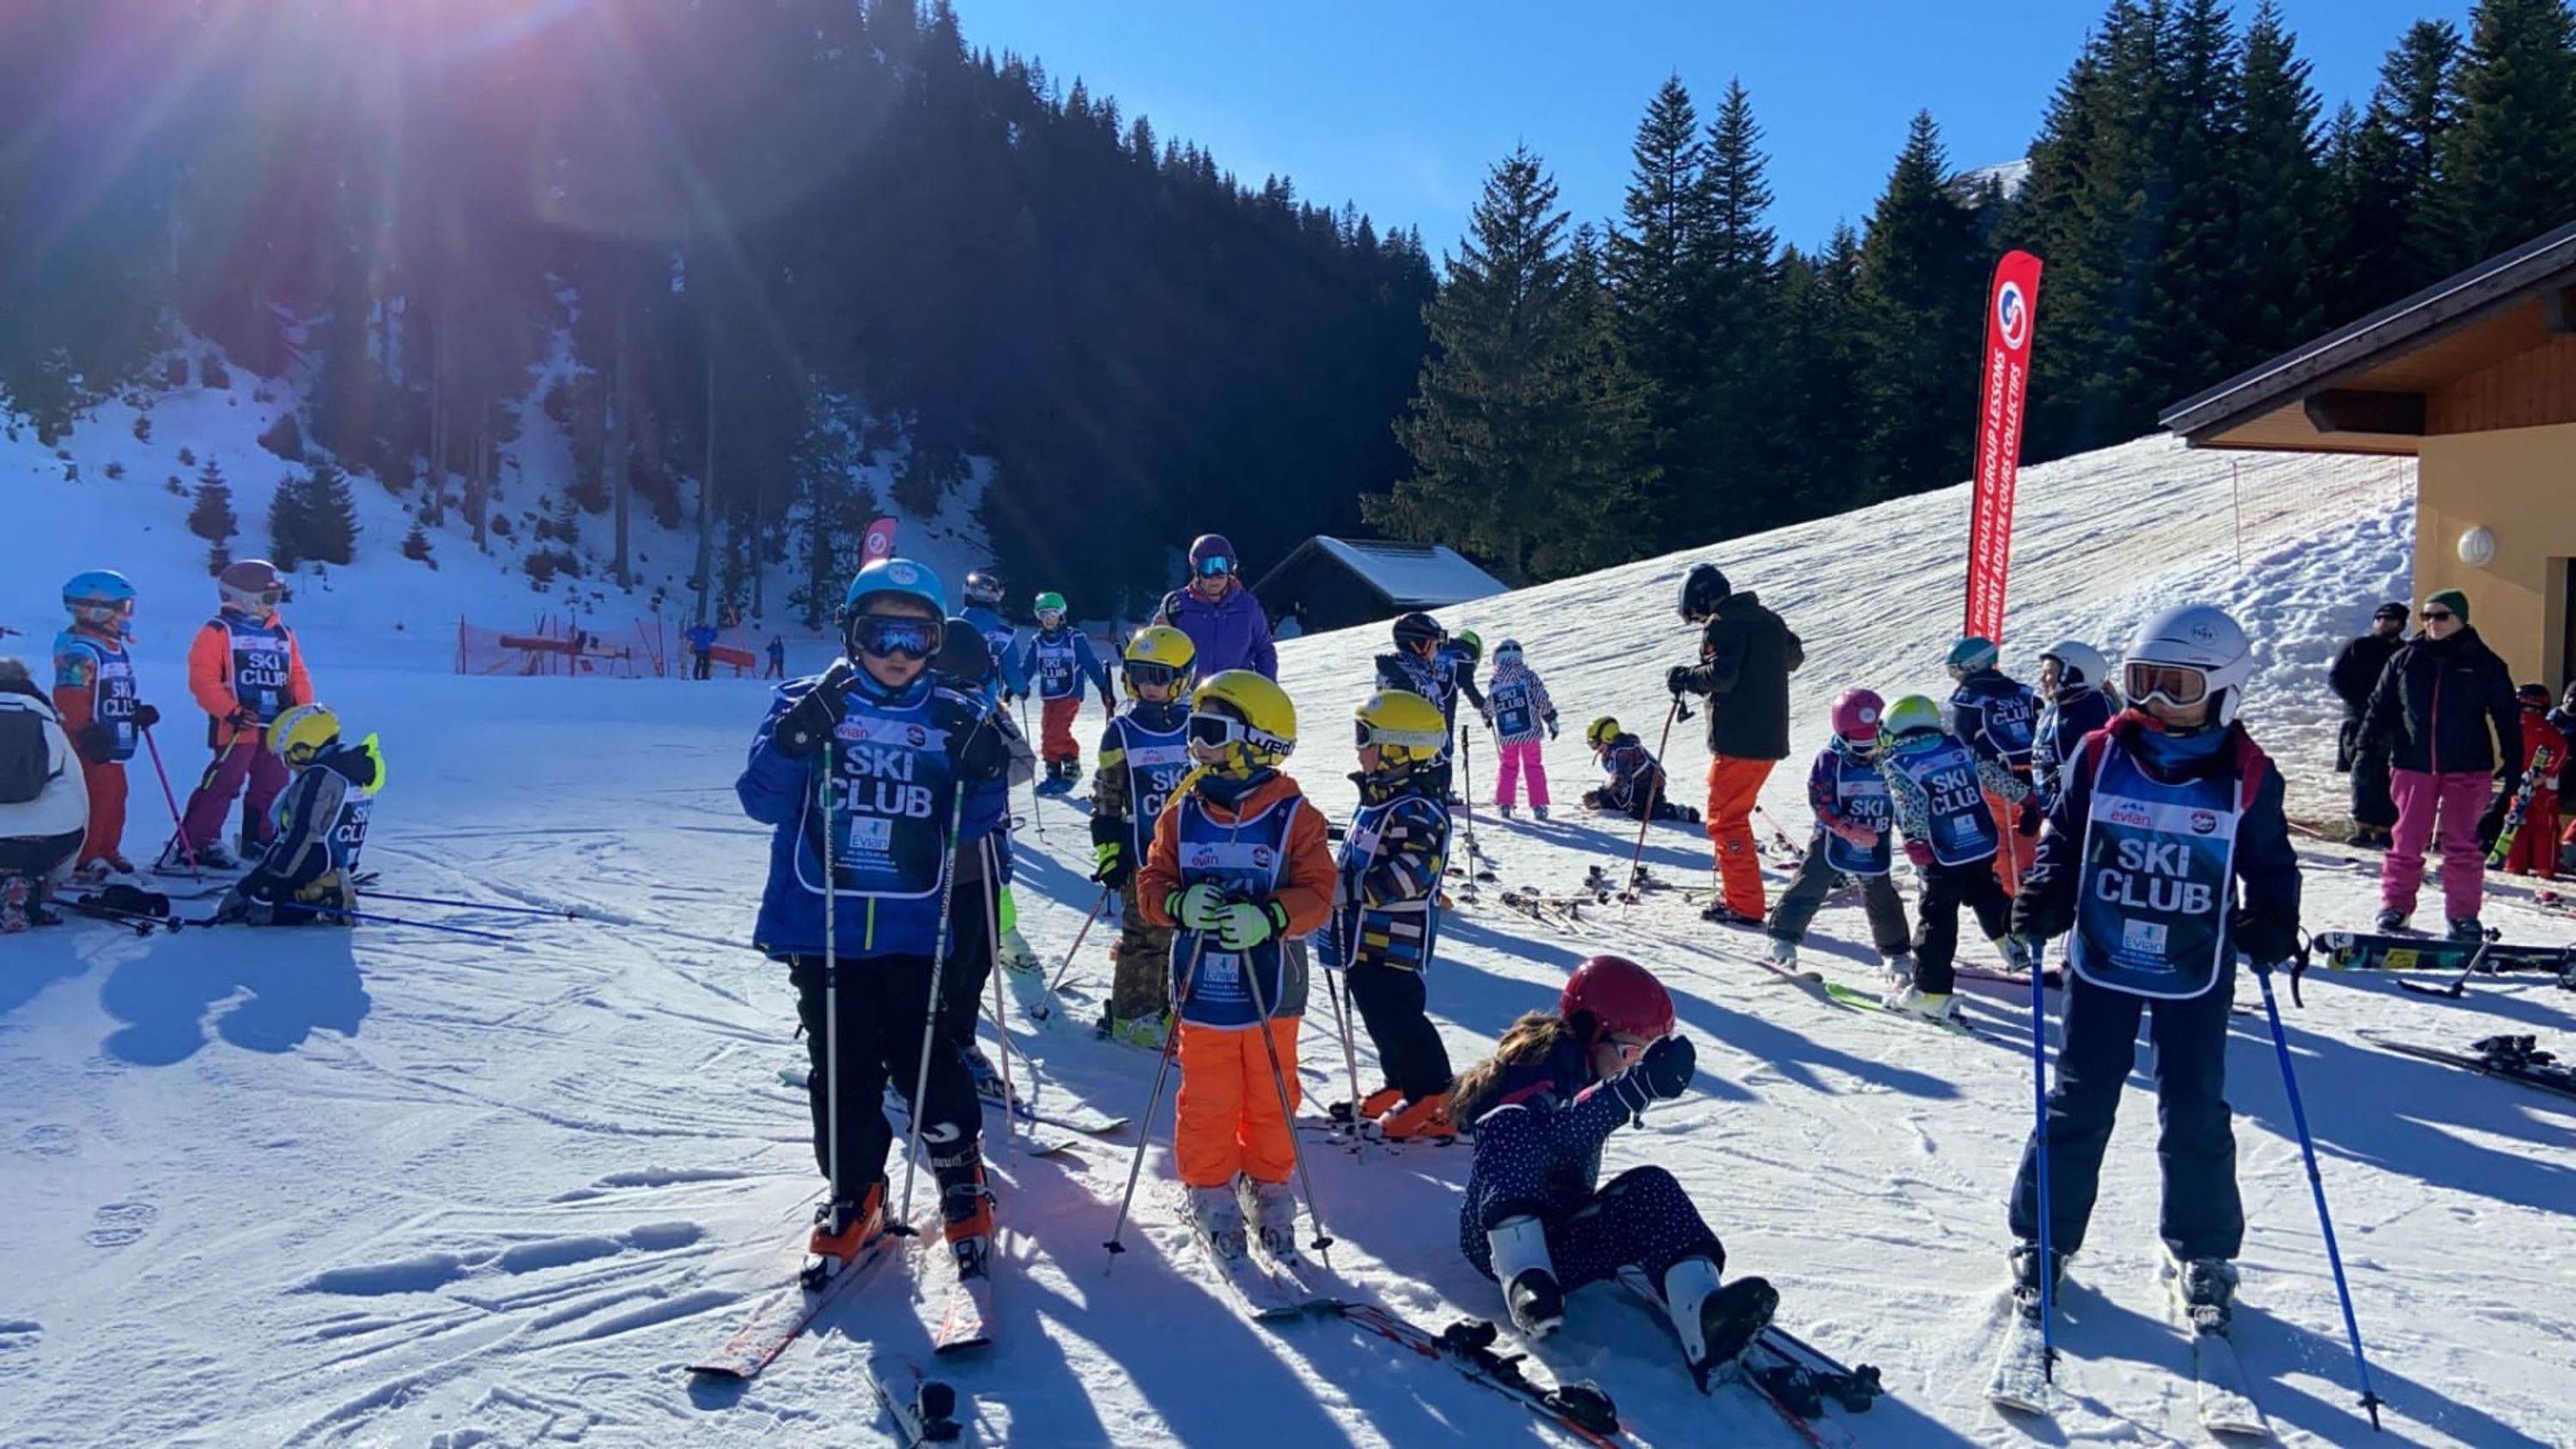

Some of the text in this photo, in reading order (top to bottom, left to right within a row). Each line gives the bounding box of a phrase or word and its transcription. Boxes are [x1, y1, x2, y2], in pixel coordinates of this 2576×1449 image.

[1989, 347, 2006, 430] LESSONS
[2003, 362, 2021, 457] COLLECTIFS
[1984, 428, 1999, 495] GROUP
[1998, 456, 2013, 513] COURS
[1978, 494, 1994, 568] ADULTS
[1991, 513, 2008, 579] ADULTE
[1975, 567, 1989, 627] POINT
[249, 652, 280, 670] SKI
[844, 744, 914, 782] SKI
[1932, 768, 1969, 793] SKI
[818, 777, 933, 817] CLUB
[1850, 799, 1885, 817] SKI
[1931, 786, 1980, 816] CLUB
[2111, 809, 2153, 828] evian
[851, 834, 889, 849] Evian
[2117, 838, 2190, 877] SKI
[2095, 868, 2213, 914] CLUB
